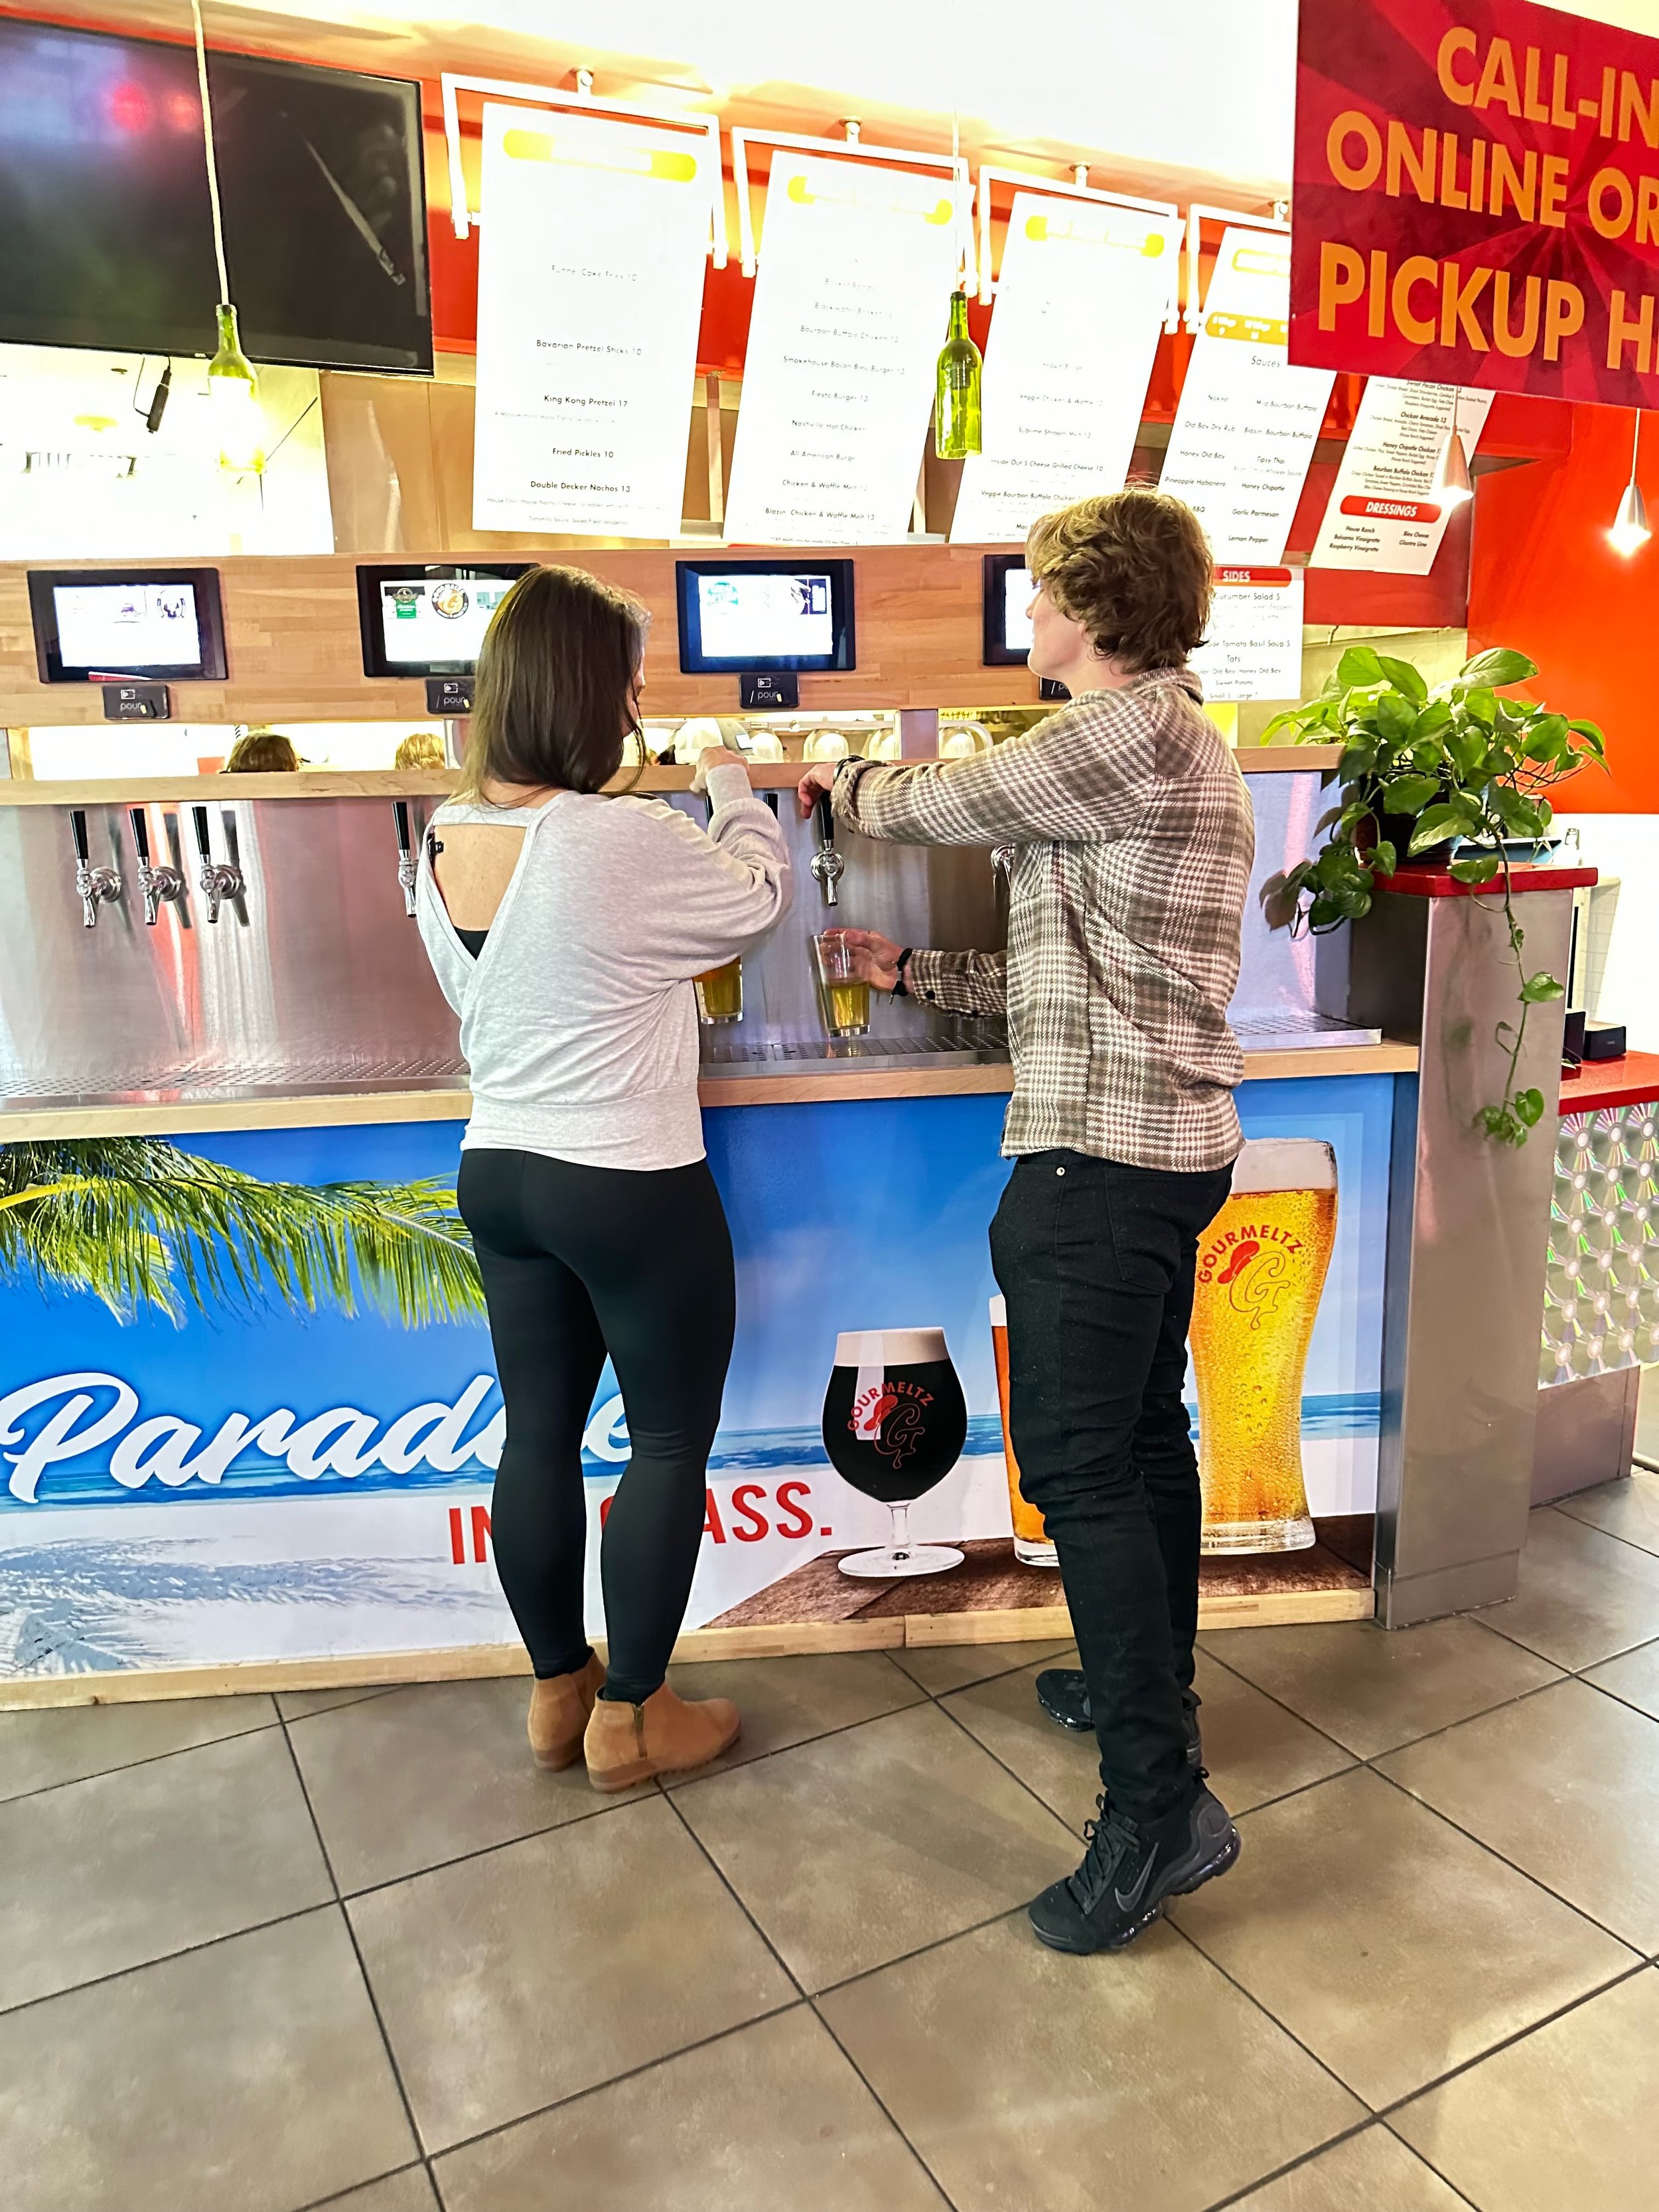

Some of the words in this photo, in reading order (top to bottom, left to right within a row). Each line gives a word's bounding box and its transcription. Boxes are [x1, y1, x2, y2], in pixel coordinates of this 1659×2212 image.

[1327, 110, 1569, 228] ONLINE
[1318, 241, 1585, 362] PICKUP
[800, 325, 831, 334] Bourbon
[536, 339, 573, 349] Bavarian
[576, 342, 604, 352] Pretzel
[607, 345, 628, 354] Sticks
[632, 347, 642, 356] 10
[783, 356, 829, 366] Smokehouse
[871, 365, 894, 374] Burger
[1251, 355, 1281, 368] Sauces
[543, 394, 562, 405] King
[565, 396, 586, 406] Kong
[589, 398, 615, 407] Pretzel
[834, 393, 857, 402] Burger
[792, 419, 824, 429] Nashville
[1419, 414, 1439, 423] Avocado
[1265, 428, 1291, 437] Bourbon
[1292, 431, 1313, 439] Buffalo
[575, 449, 601, 458] Pickles
[802, 451, 834, 460] American
[836, 453, 857, 463] Burge
[1180, 449, 1199, 458] Honey
[1257, 455, 1272, 465] Tipsy
[530, 480, 558, 490] Double
[561, 482, 587, 490] Decker
[590, 484, 618, 492] Nachos
[782, 479, 809, 487] Chicken
[1165, 476, 1195, 485] Pineapple
[1196, 479, 1226, 487] Habanero
[1242, 482, 1261, 491] Honey
[1262, 483, 1285, 492] Chipotle
[981, 490, 1001, 498] Veggie
[1251, 509, 1279, 518] Parmesan
[1365, 500, 1418, 518] DRESSINGS
[1329, 543, 1353, 552] Raspberry
[1222, 571, 1251, 583] SIDES
[444, 696, 466, 706] pour
[758, 691, 778, 701] pour
[120, 701, 142, 712] pour
[1197, 1224, 1305, 1284] GOURMELTZ
[847, 1381, 935, 1432] GOURMELTZ
[0, 1372, 632, 1504] Parade
